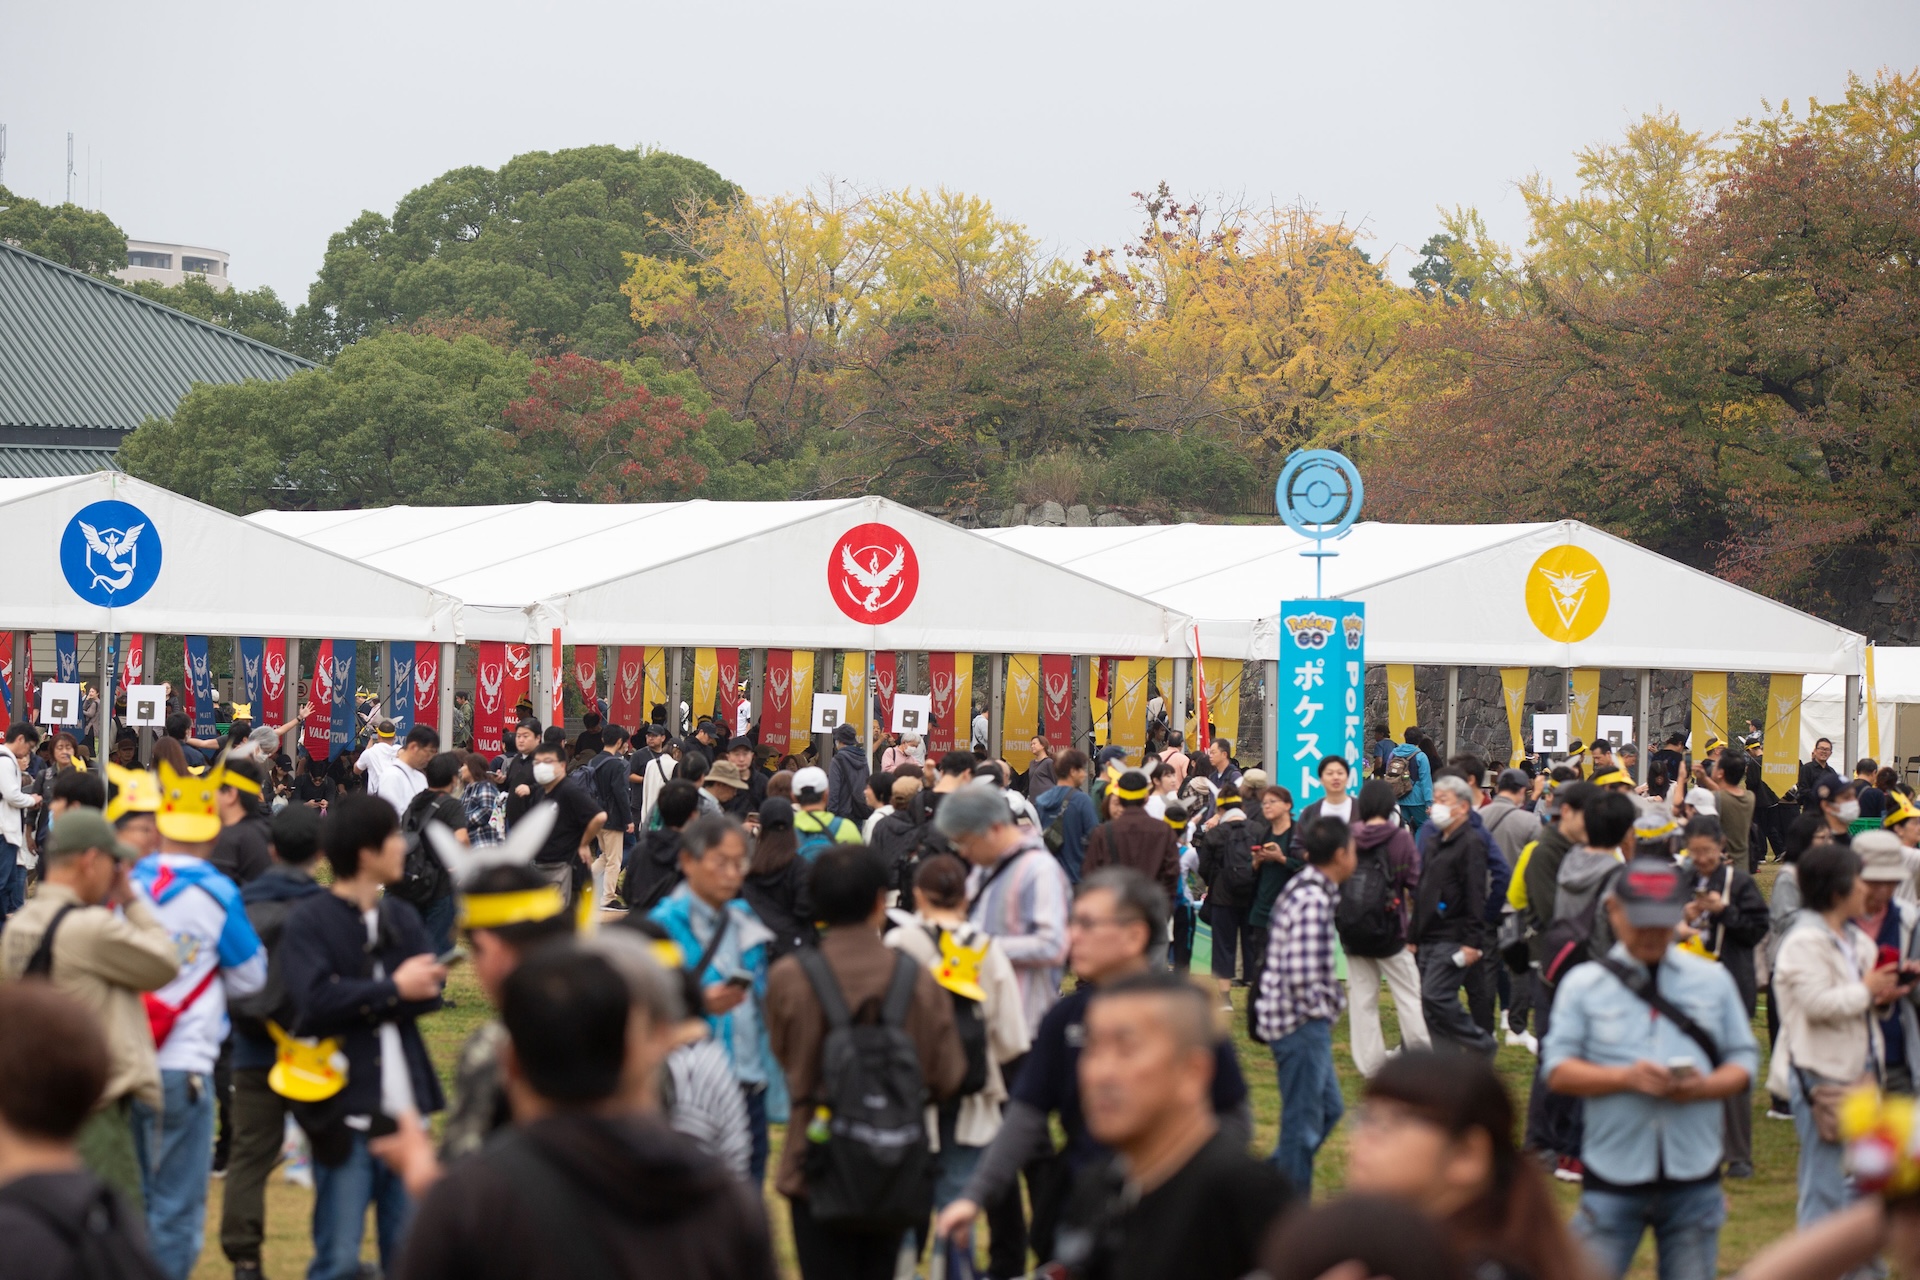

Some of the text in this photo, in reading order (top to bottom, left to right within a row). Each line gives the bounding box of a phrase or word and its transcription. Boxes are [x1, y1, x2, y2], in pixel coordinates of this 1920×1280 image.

[1297, 632, 1325, 646] GO
[504, 716, 521, 724] VALO
[309, 726, 331, 740] VALO
[483, 726, 498, 734] TEAM
[1293, 657, 1325, 812] ポケスト
[1005, 740, 1032, 751] INSTIN
